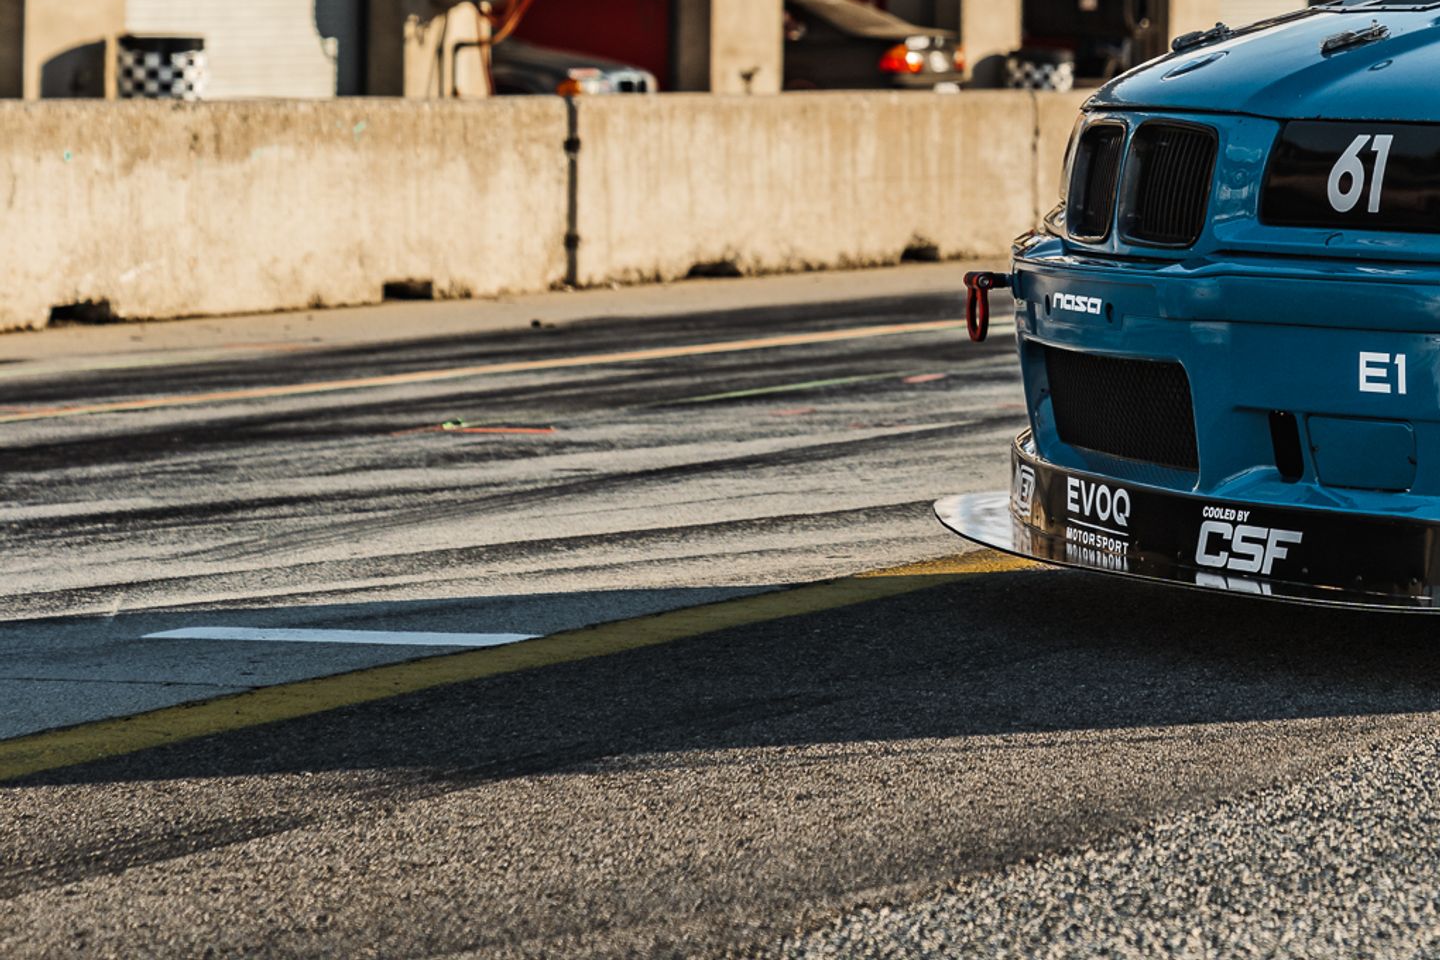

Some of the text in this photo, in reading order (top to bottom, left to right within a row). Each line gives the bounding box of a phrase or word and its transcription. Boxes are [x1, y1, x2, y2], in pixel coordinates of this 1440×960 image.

[1327, 134, 1394, 213] 61
[1053, 292, 1102, 315] nasa
[1359, 351, 1407, 395] E1
[1067, 476, 1131, 527] EVOQ
[1202, 505, 1250, 522] COOLED BY
[1066, 526, 1129, 555] MOTORSPORT
[1195, 521, 1303, 575] CSF
